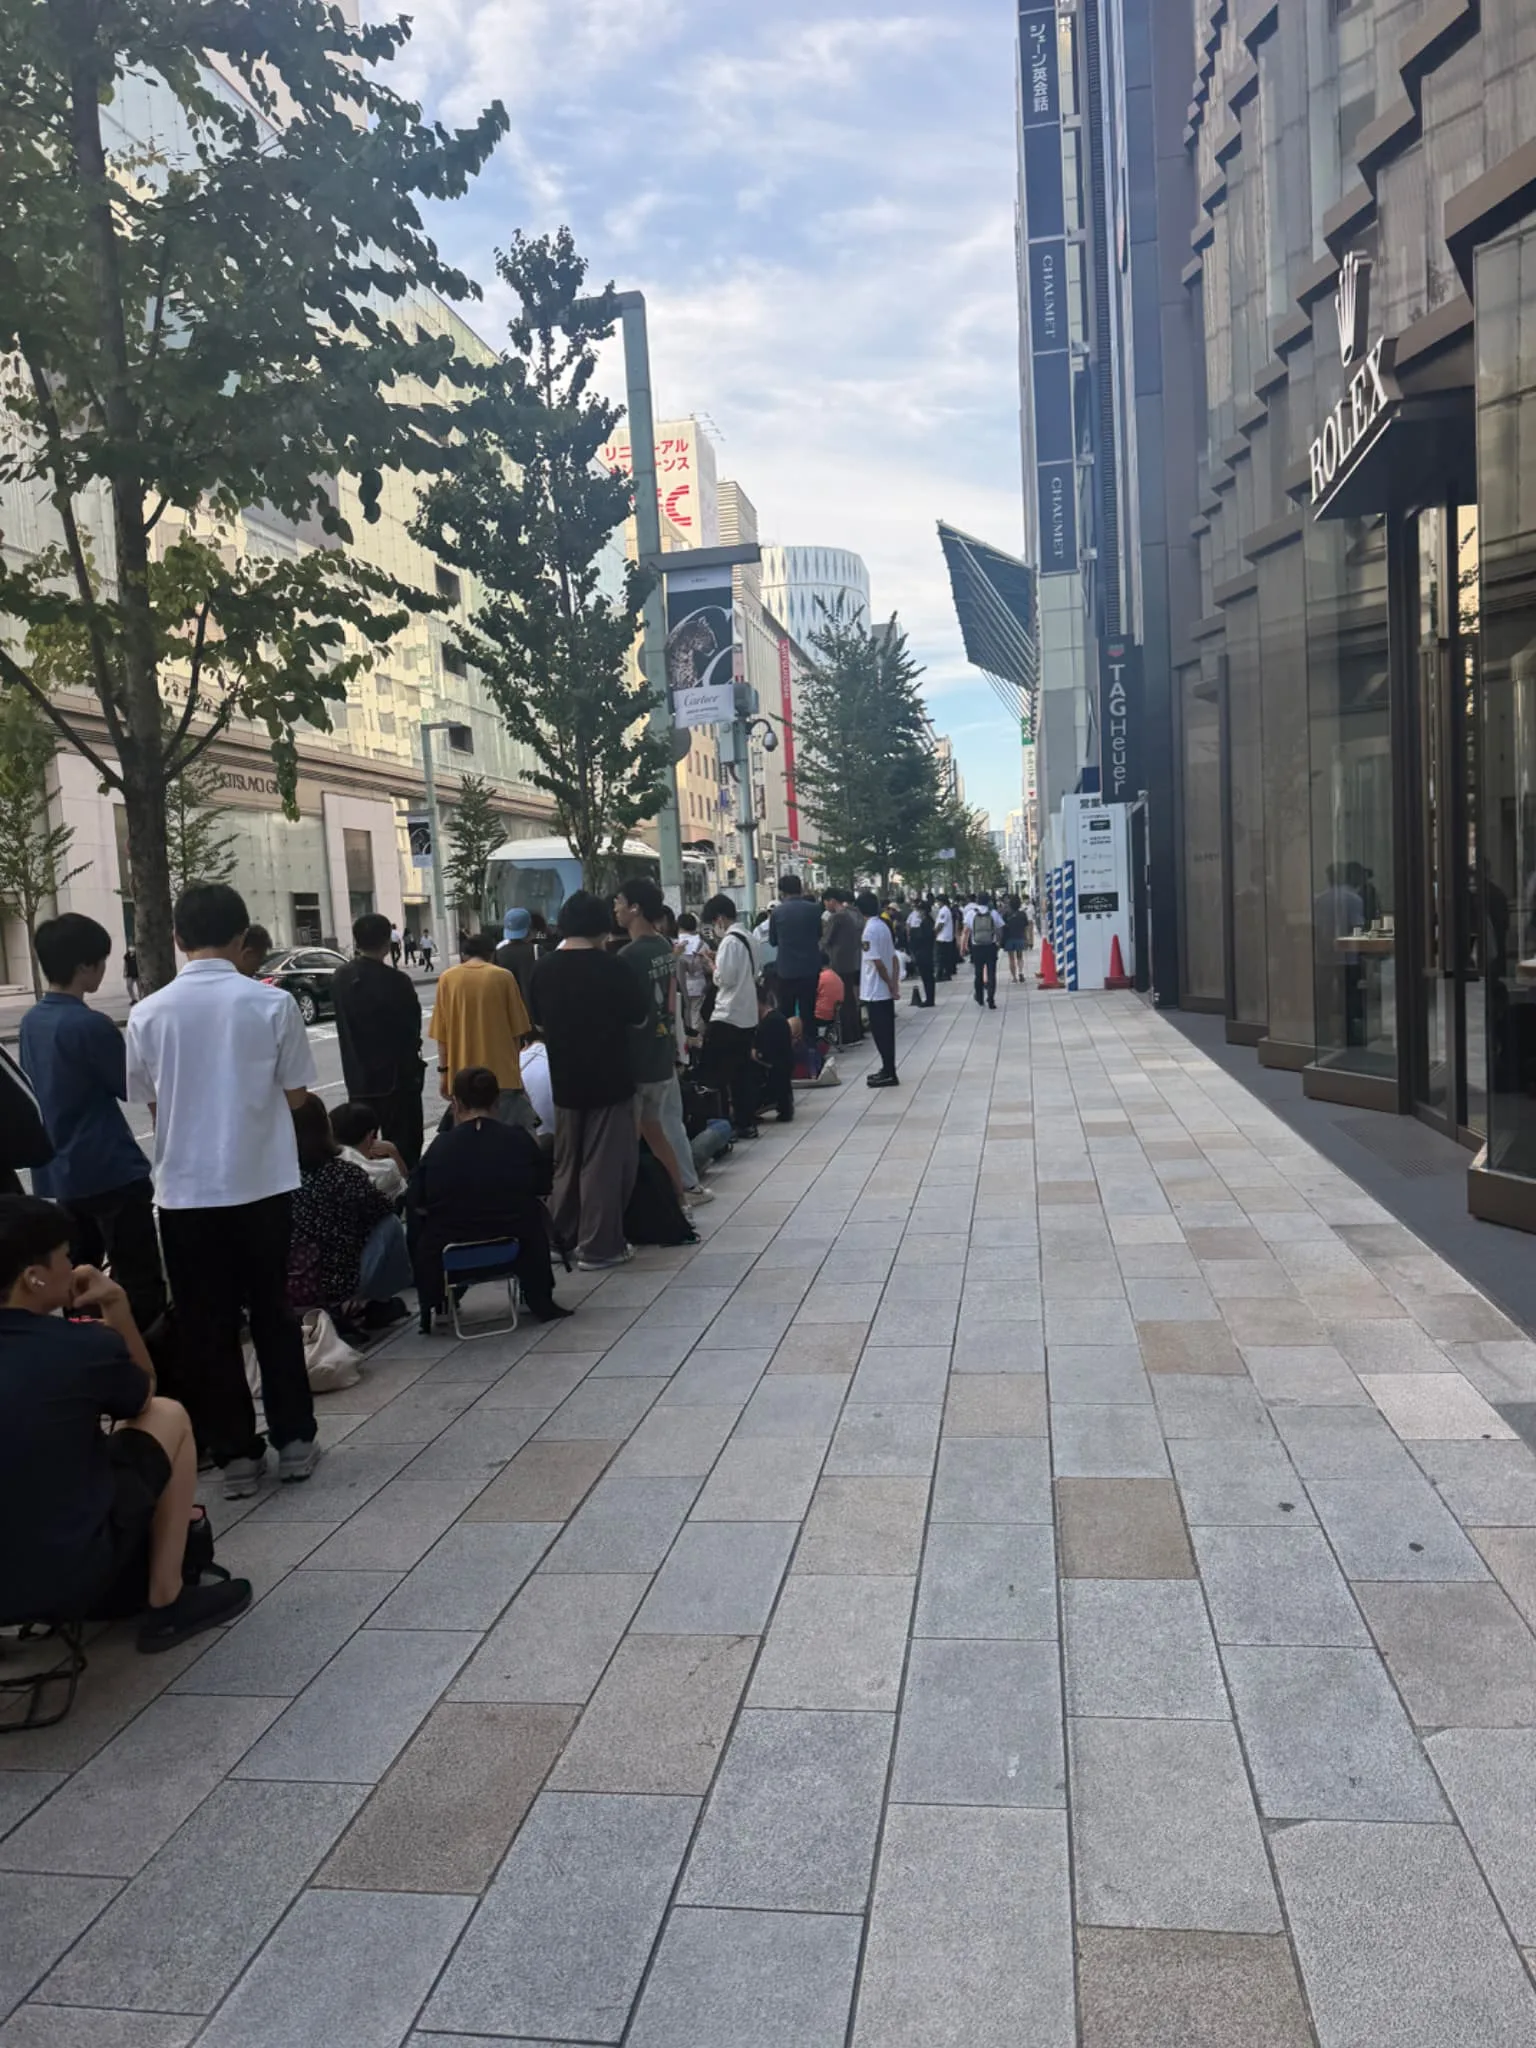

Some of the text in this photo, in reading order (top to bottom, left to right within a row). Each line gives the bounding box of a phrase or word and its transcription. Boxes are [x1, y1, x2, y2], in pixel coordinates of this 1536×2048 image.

[1030, 23, 1049, 112] ジェーン英会話
[1042, 254, 1056, 338] CHAUMET
[1308, 335, 1388, 504] ROLEX
[1052, 476, 1064, 558] CHAUMET
